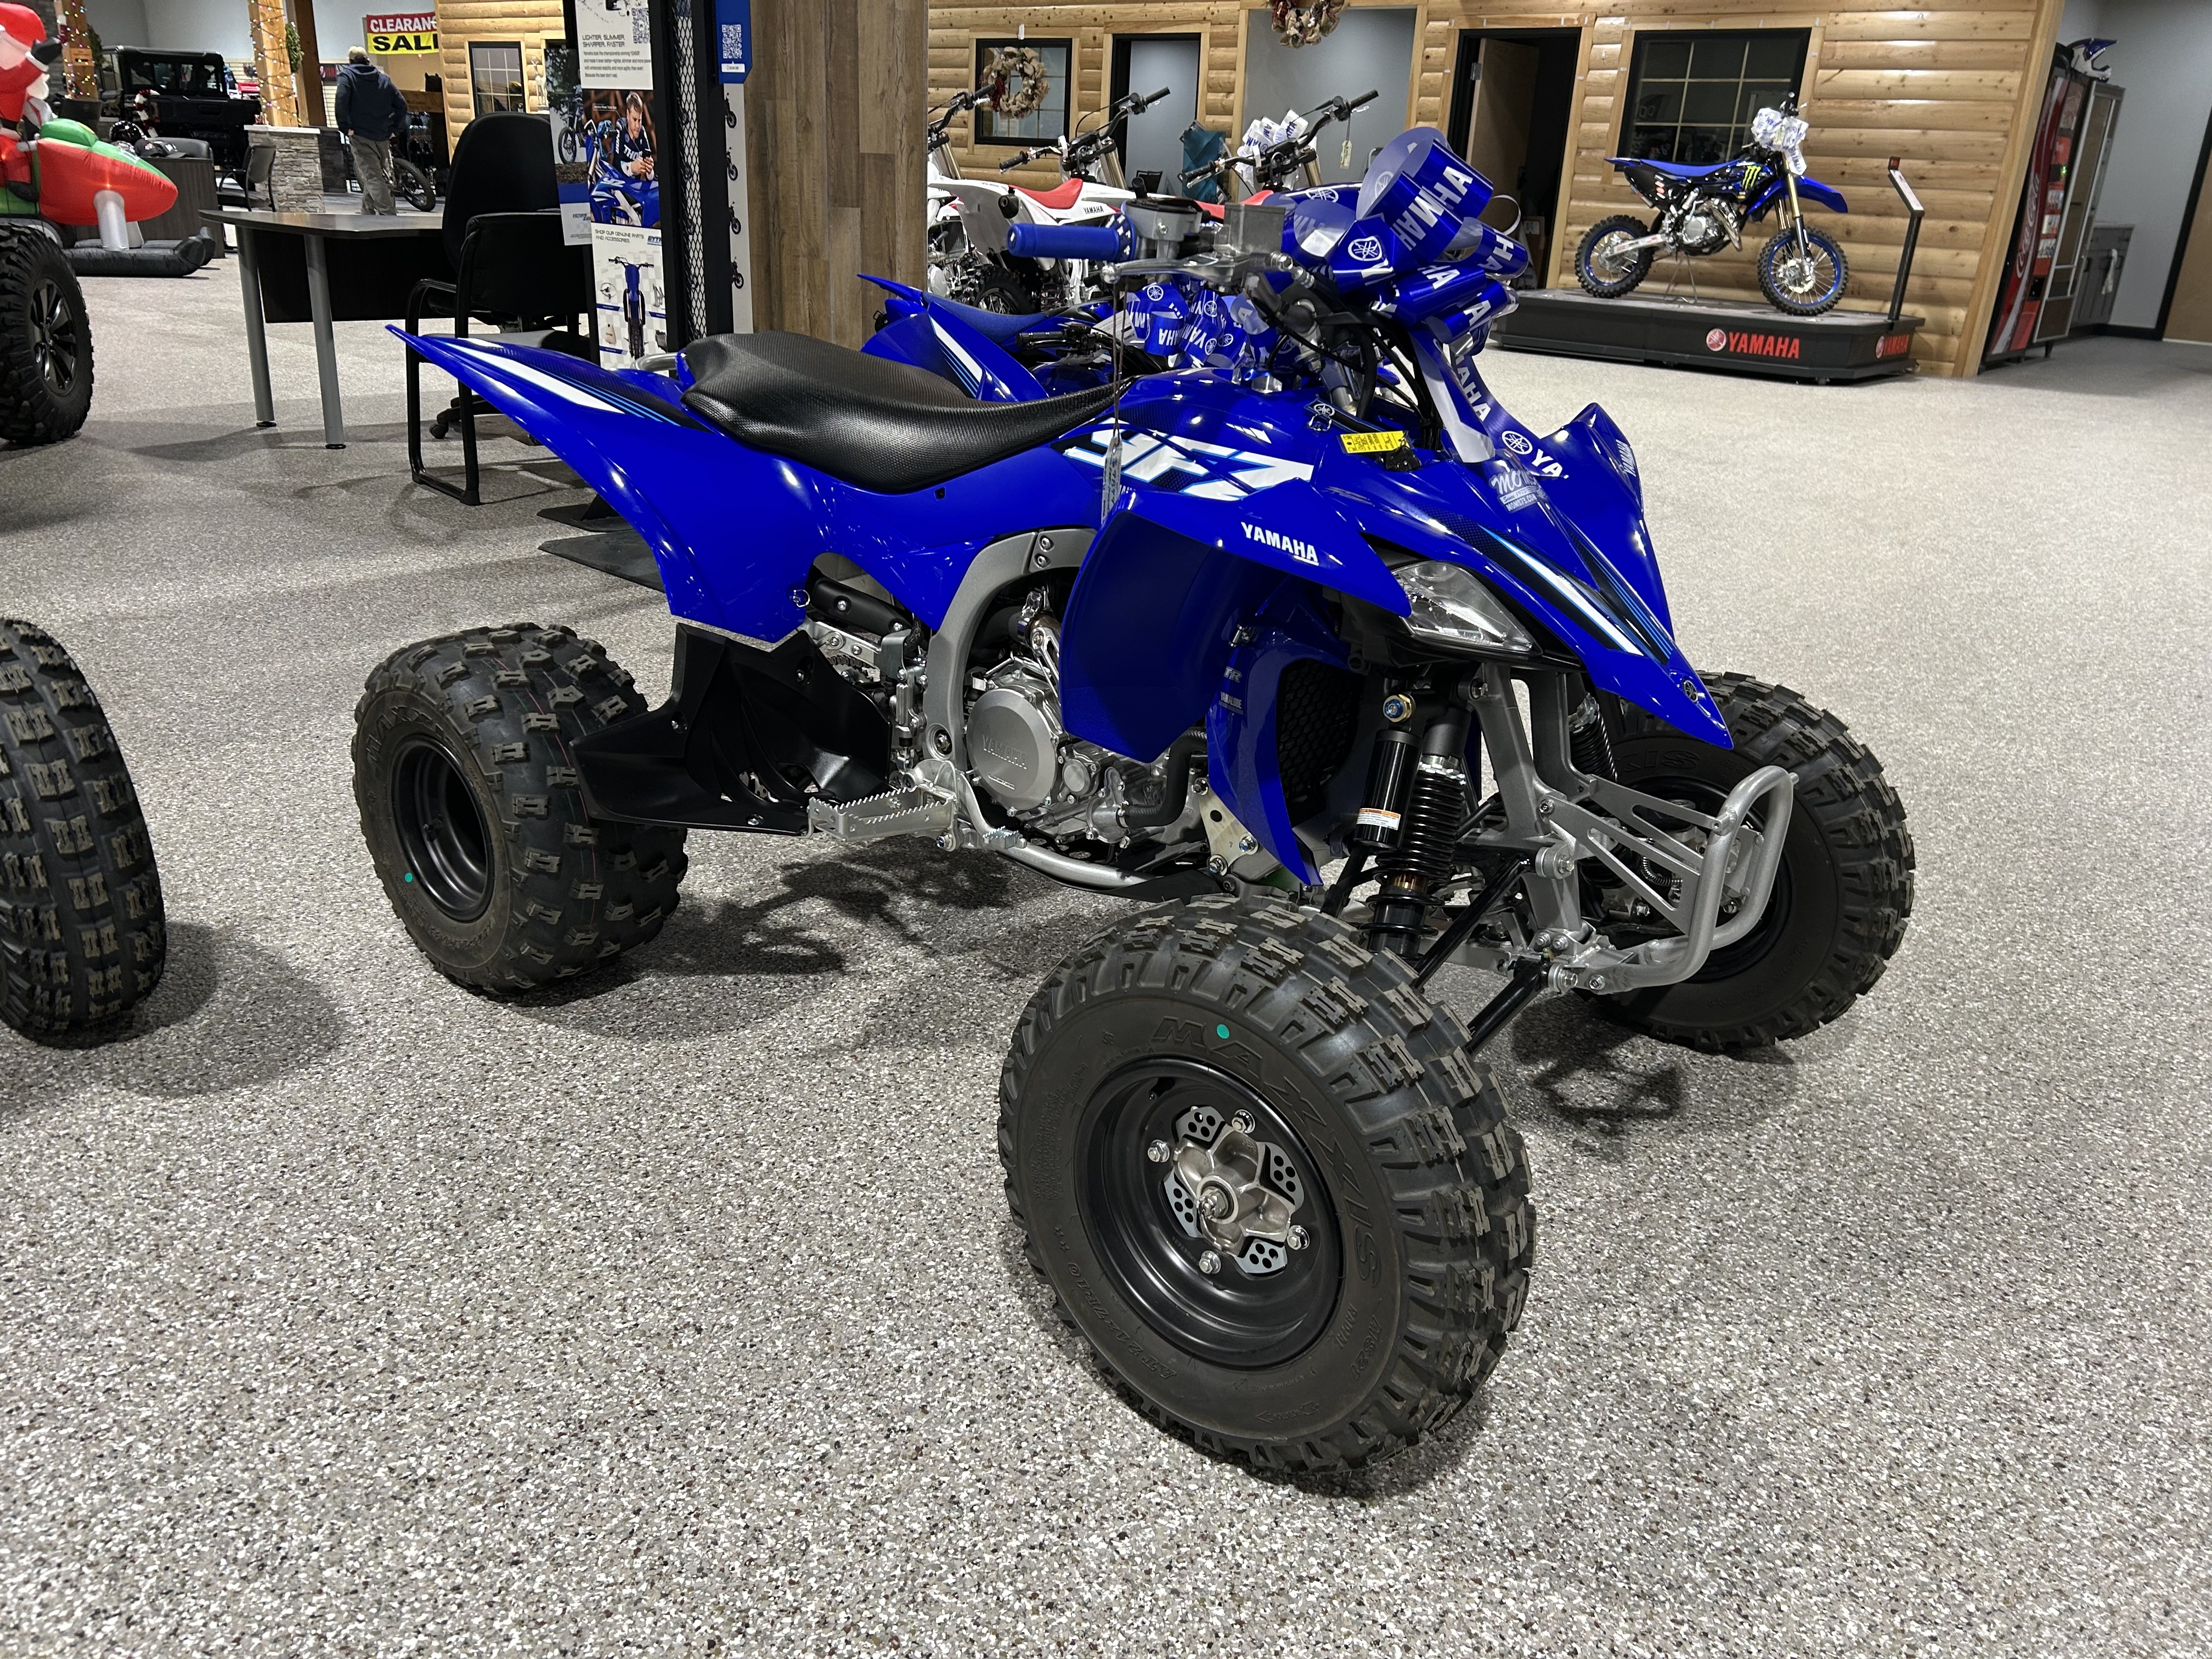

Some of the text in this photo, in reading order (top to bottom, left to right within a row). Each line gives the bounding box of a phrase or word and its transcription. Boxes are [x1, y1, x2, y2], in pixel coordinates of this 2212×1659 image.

[1083, 205, 1104, 215] YAMAHA
[1729, 331, 1800, 359] YAMAHA
[1884, 334, 1910, 356] YAMAHA
[1240, 522, 1318, 563] YAMAHA
[1220, 691, 1243, 709] YAMALUBE
[982, 734, 1028, 770] YAMAHA
[1150, 1015, 1384, 1288] MAXXIS
[1348, 1314, 1382, 1383] MS21
